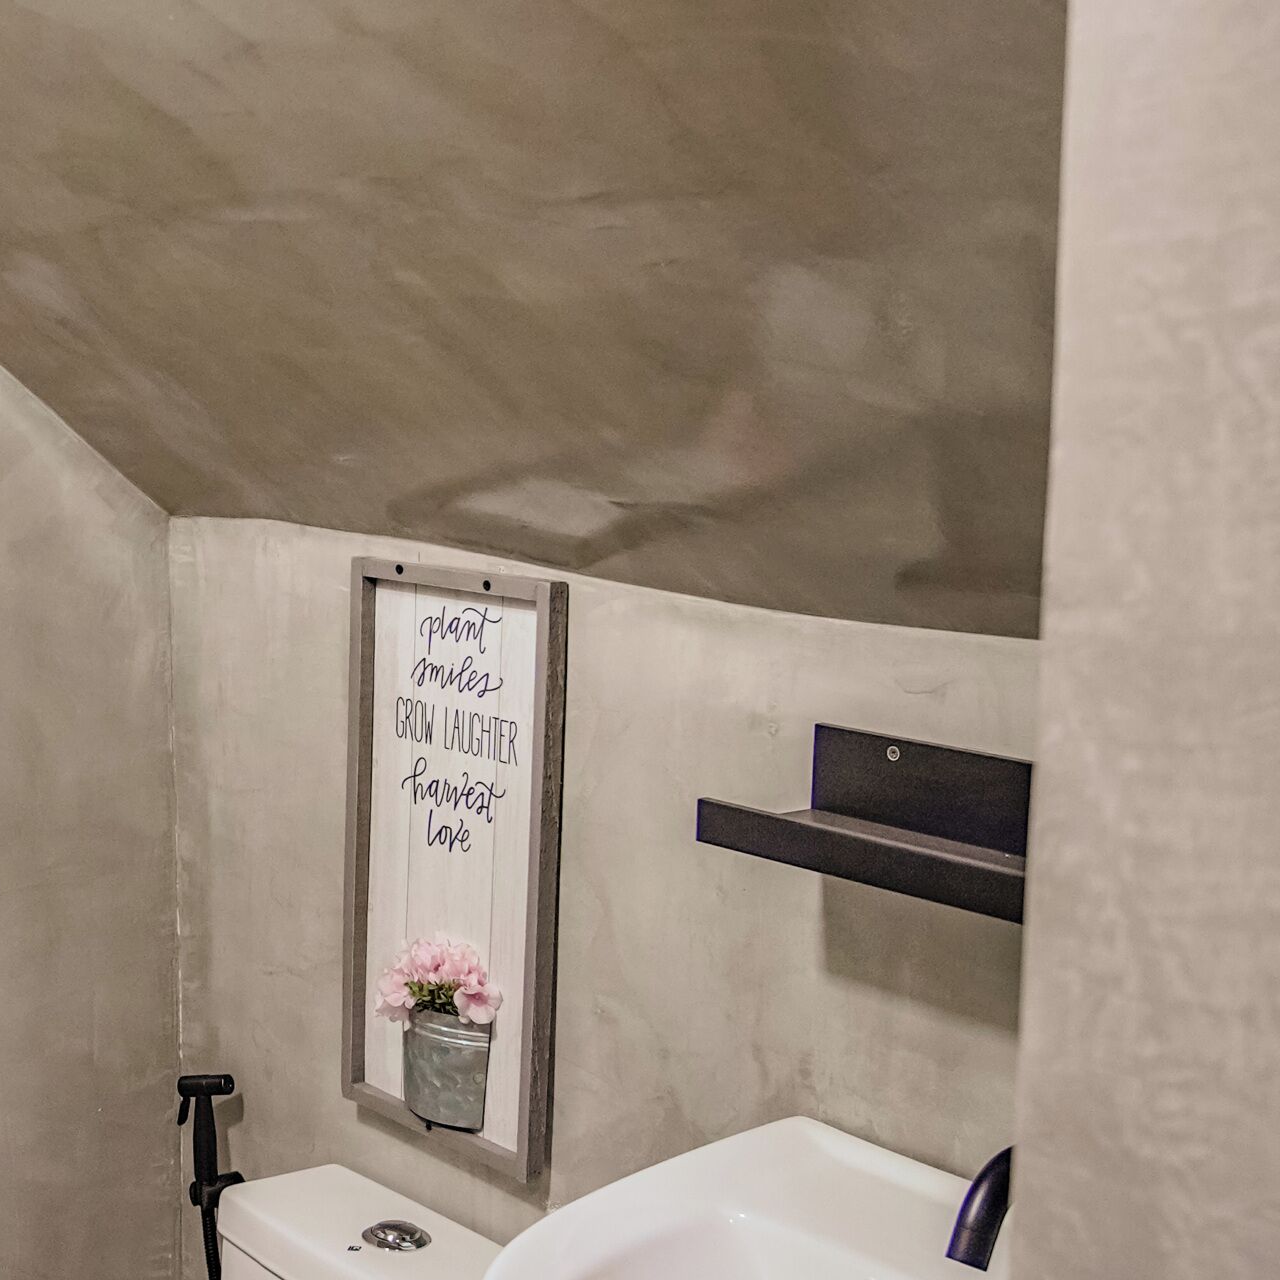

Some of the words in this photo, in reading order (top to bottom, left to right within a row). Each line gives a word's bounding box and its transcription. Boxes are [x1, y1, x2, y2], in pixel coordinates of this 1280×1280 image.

[420, 605, 502, 655] plant
[411, 656, 503, 698] smiles
[395, 696, 435, 745] GROW
[444, 706, 518, 766] LAUGHTER
[401, 757, 506, 823] harvest
[427, 809, 471, 852] love
